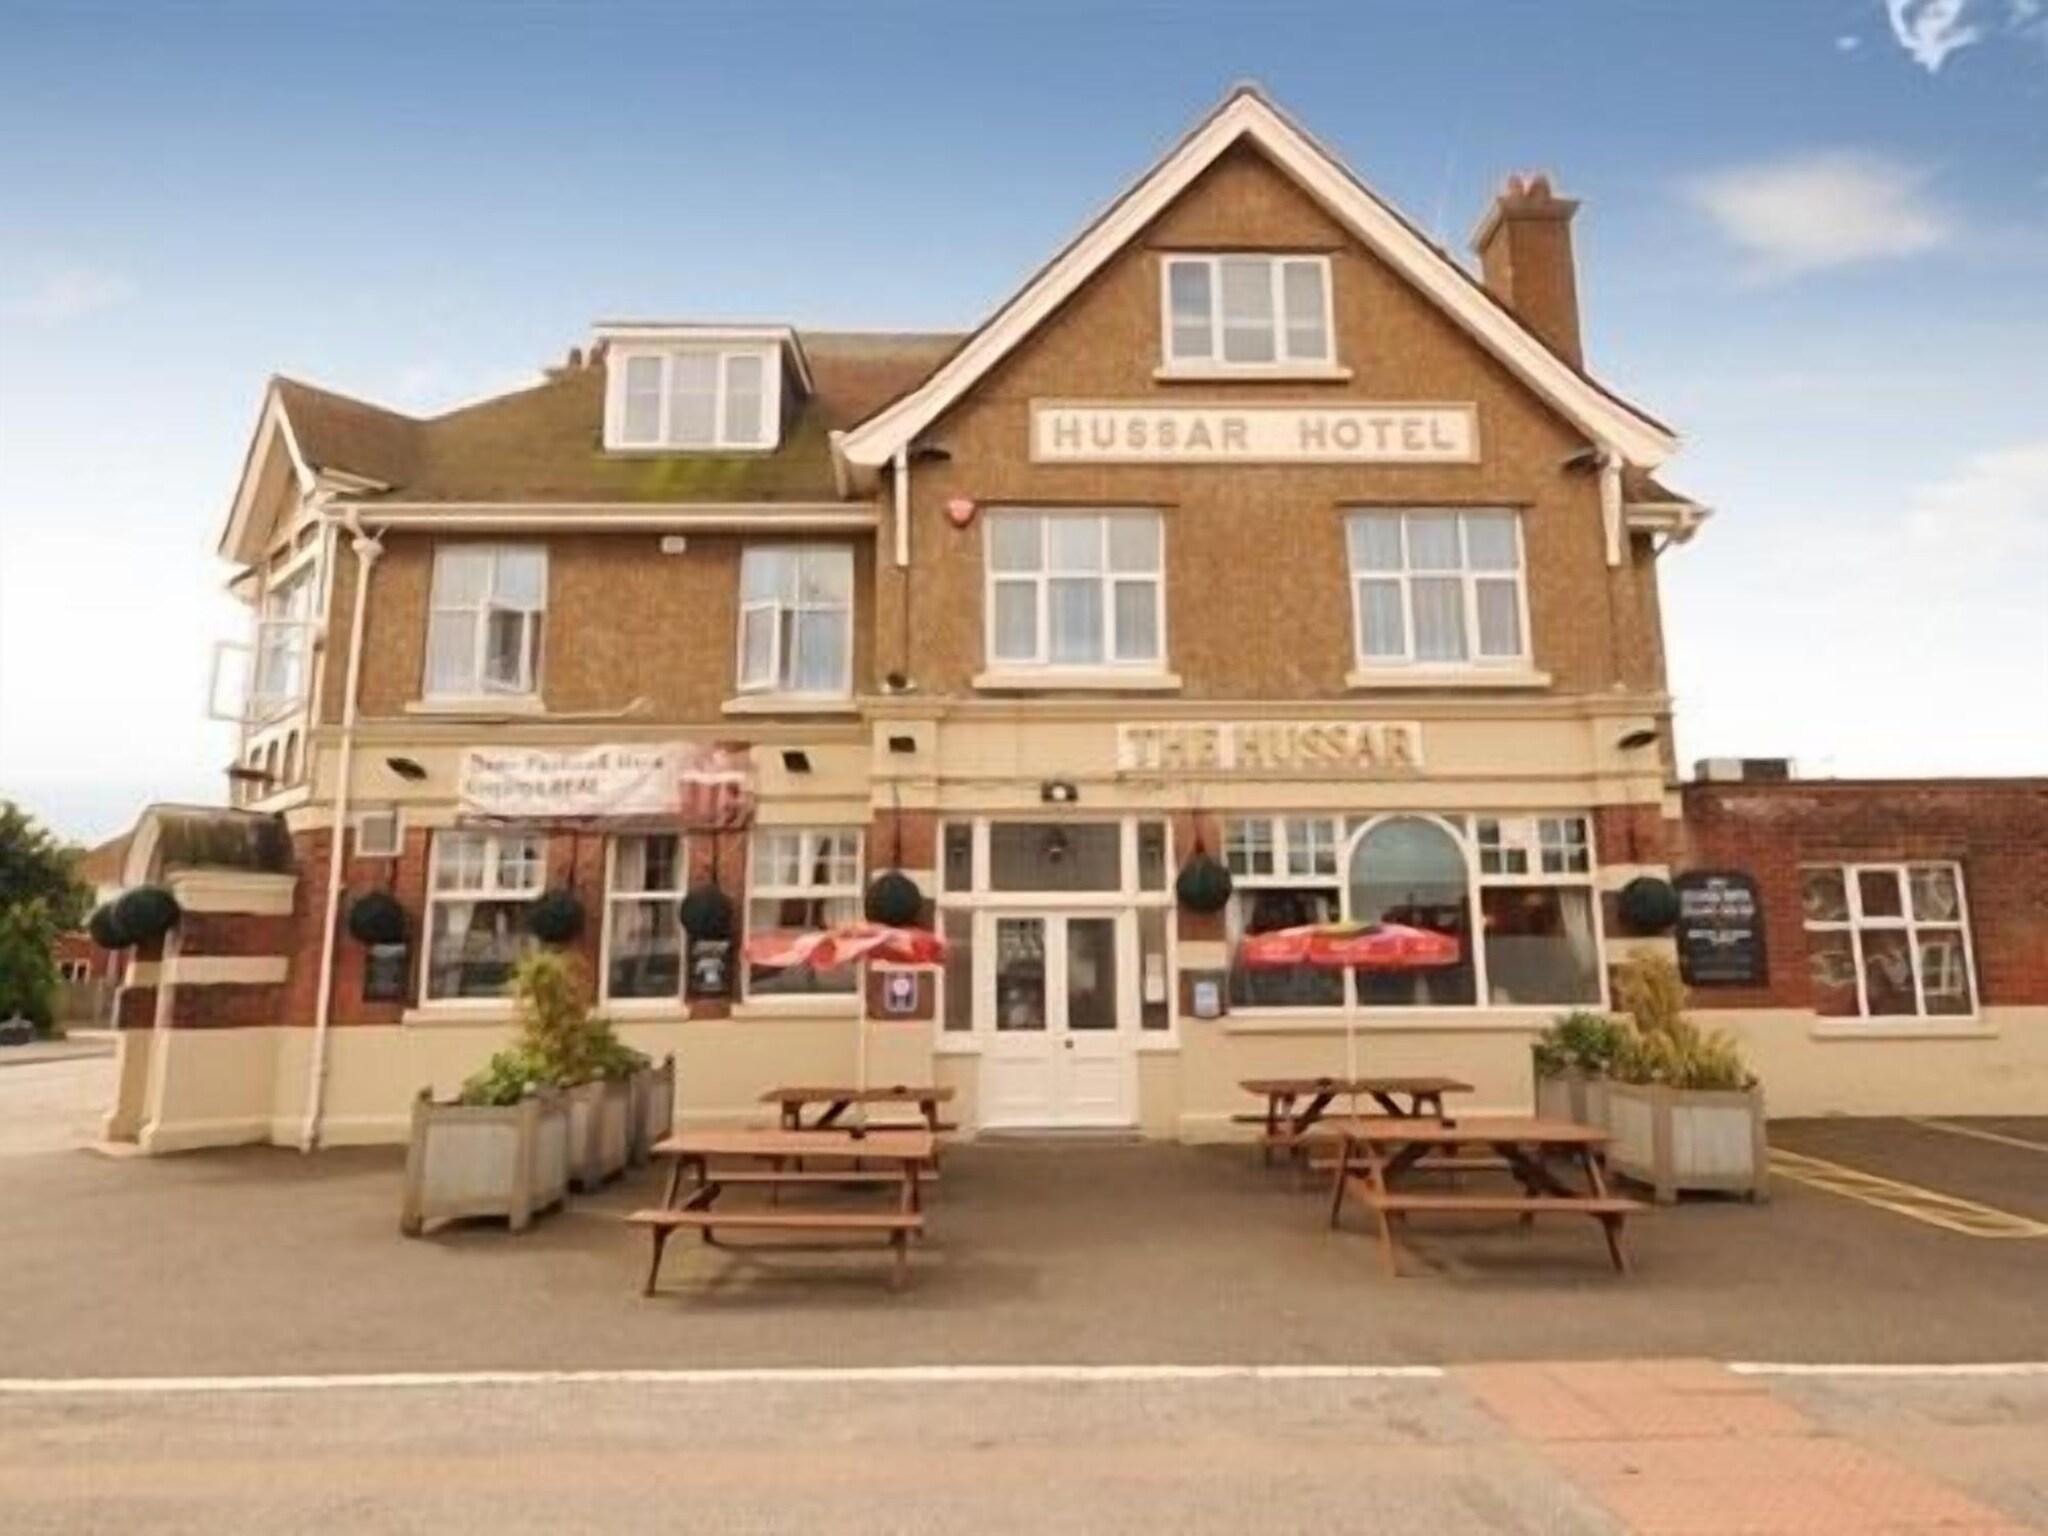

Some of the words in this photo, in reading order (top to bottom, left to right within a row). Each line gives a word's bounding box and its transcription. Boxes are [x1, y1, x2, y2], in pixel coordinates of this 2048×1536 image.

[1052, 416, 1249, 452] HUSSAR
[1301, 416, 1456, 452] HOTEL
[1126, 727, 1219, 769] THE
[1234, 727, 1414, 770] HUSSAR
